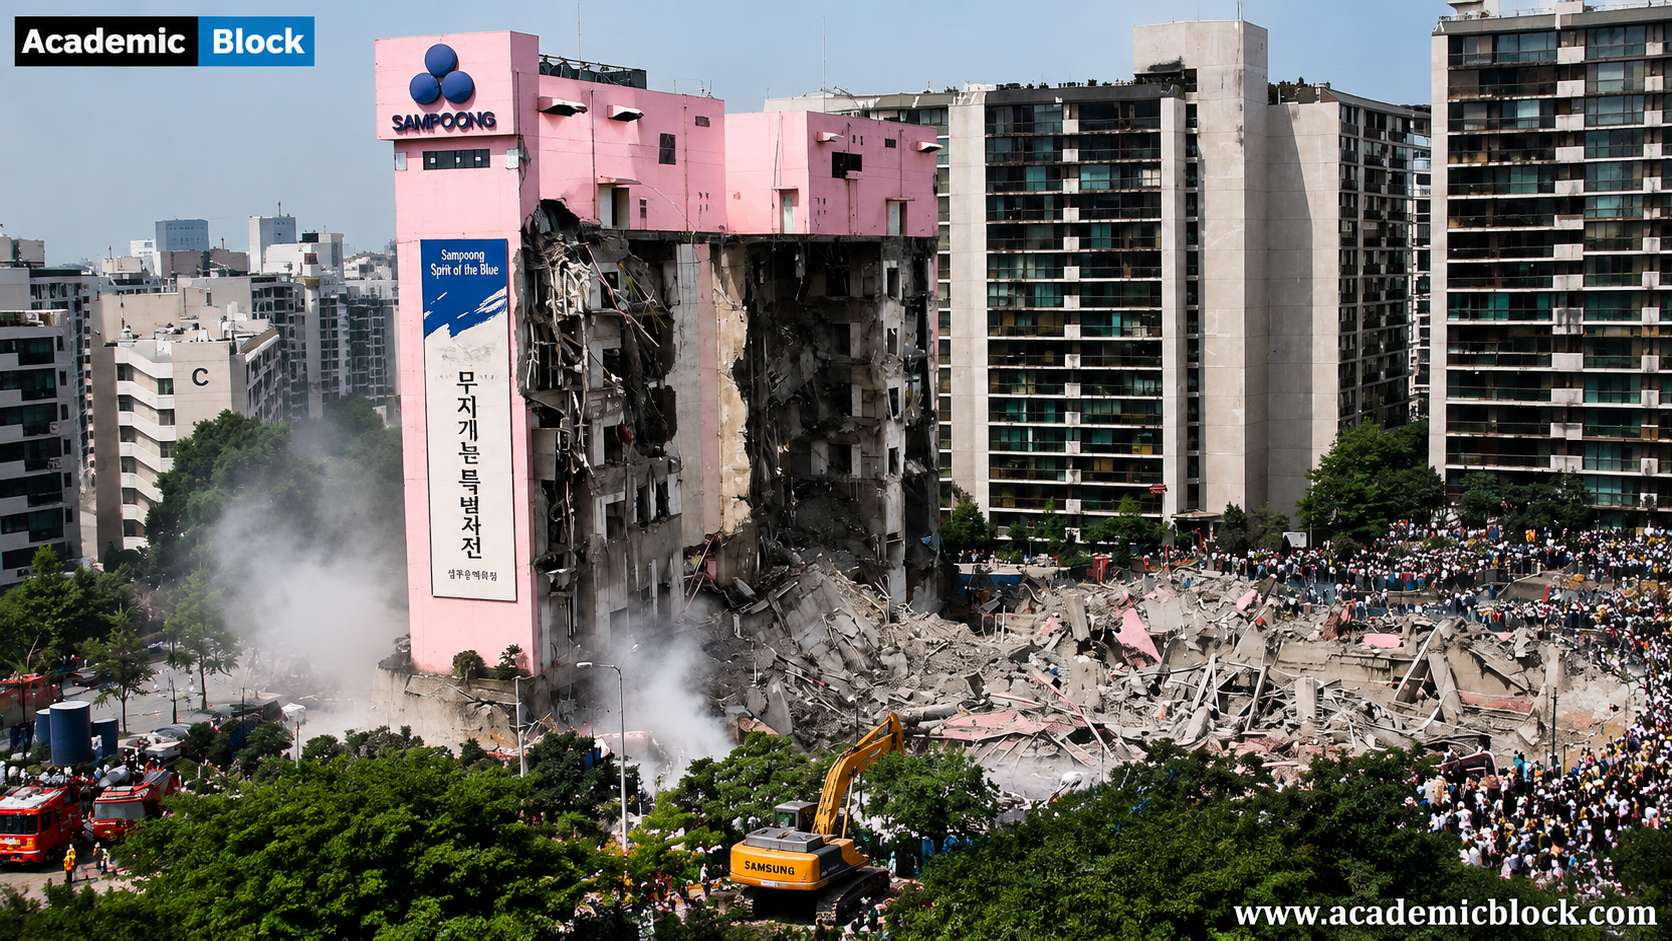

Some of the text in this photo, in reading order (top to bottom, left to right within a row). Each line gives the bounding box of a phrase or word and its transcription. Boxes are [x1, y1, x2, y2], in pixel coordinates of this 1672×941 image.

[392, 111, 497, 133] SAMPOONG
[441, 249, 485, 263] Sampoong
[453, 264, 462, 275] of
[464, 264, 478, 275] the
[480, 263, 499, 275] Blue
[191, 367, 209, 386] C
[744, 860, 795, 876] SAMSUNG
